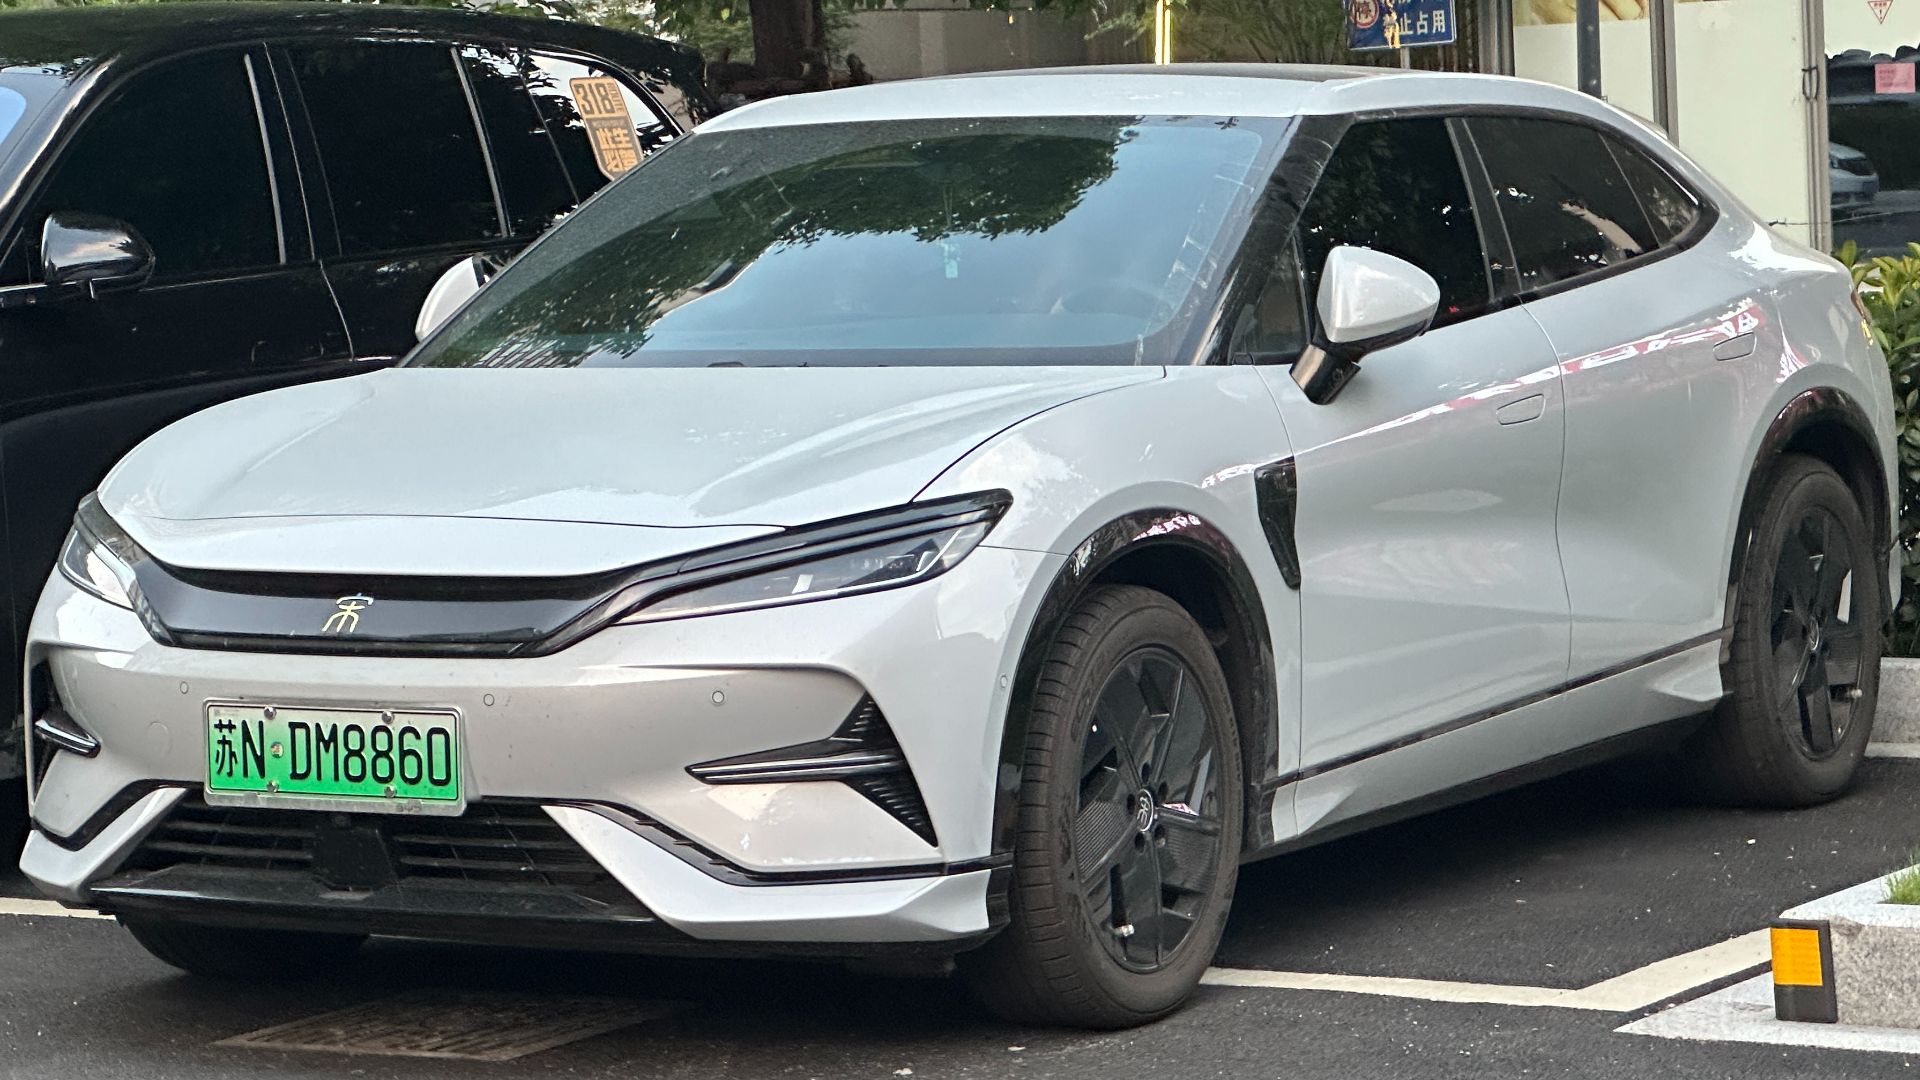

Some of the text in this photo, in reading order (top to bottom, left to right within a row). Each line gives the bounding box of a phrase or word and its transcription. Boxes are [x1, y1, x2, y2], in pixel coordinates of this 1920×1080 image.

[574, 83, 615, 114] 318
[596, 127, 633, 149] 此生
[213, 719, 452, 787] 苏N DM8860
